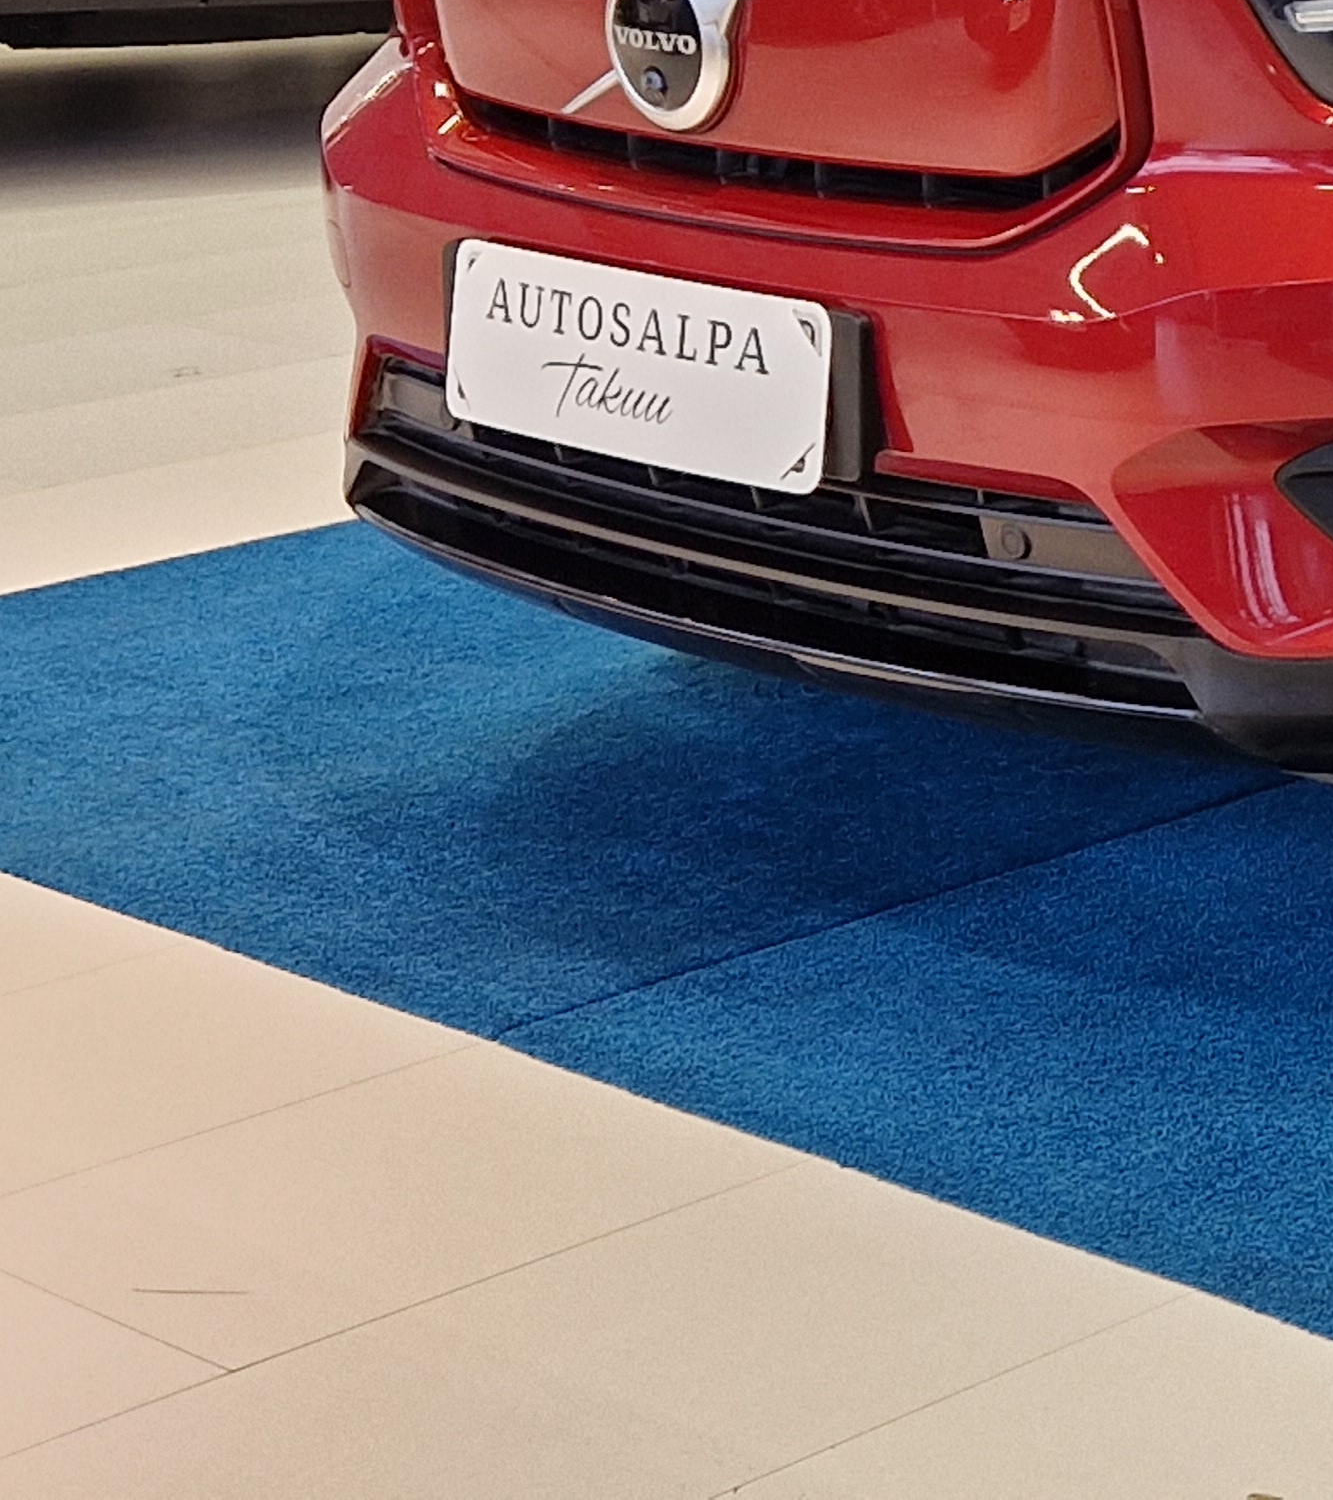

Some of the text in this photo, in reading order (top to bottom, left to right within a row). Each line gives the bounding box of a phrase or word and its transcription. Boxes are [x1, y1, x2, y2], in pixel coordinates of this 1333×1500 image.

[613, 24, 697, 56] VOLVO
[486, 277, 770, 376] AUTOSALPA
[541, 353, 674, 425] Takuu
